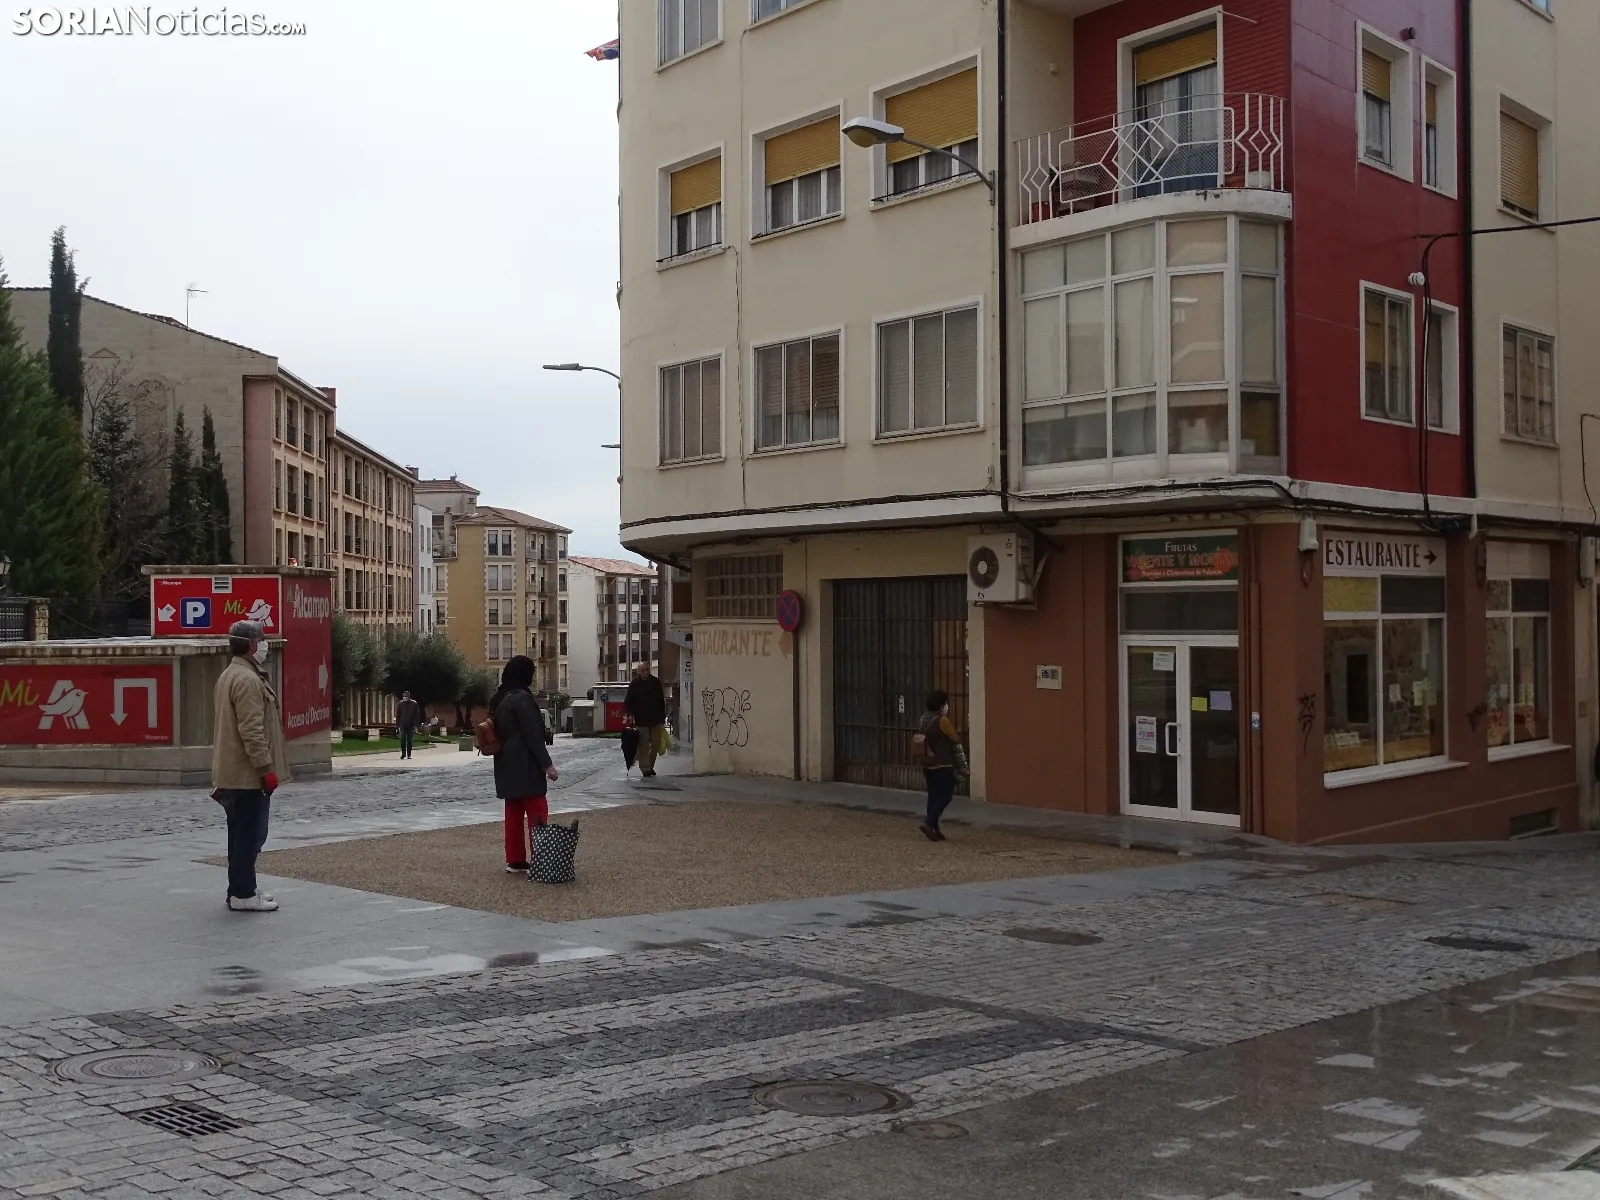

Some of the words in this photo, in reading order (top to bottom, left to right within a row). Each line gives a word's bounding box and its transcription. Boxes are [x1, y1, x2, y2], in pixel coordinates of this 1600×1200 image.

[1165, 541, 1198, 553] FRUTAS
[1325, 539, 1421, 568] ESTAURANTE
[186, 601, 206, 625] P
[223, 598, 247, 615] Mi
